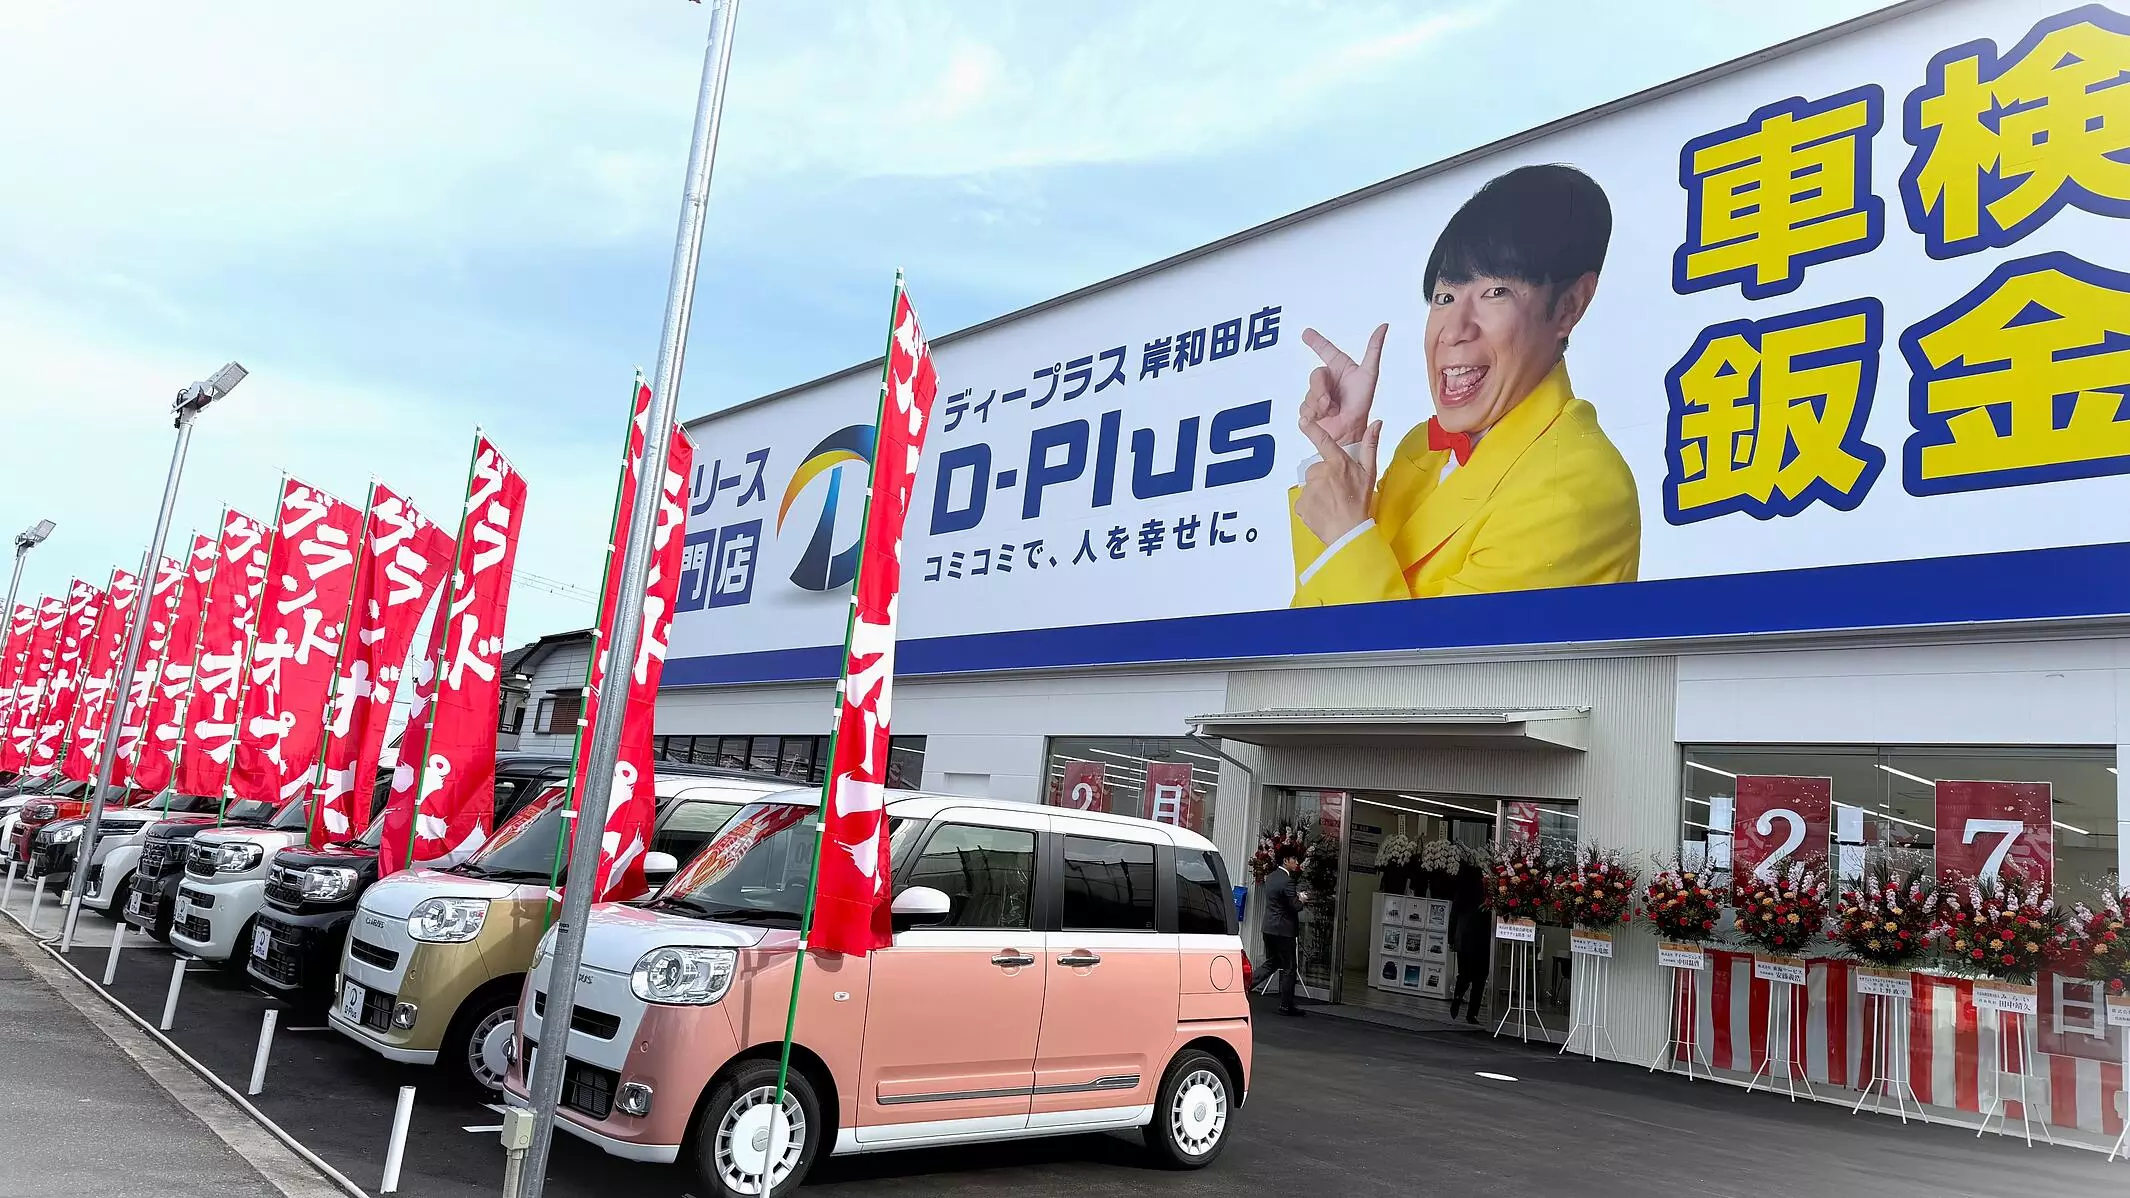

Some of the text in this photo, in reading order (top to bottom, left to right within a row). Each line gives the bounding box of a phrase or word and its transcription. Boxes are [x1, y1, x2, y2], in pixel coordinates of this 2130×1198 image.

[1673, 4, 2130, 300] 車検
[943, 304, 1283, 434] ディープラス 岸和田店
[1664, 251, 2130, 525] 鈑金
[687, 446, 772, 517] リース
[929, 398, 1276, 537] D-Plus
[923, 509, 1260, 583] コミコミで、人を幸せに。
[1753, 808, 2024, 888] 2 7
[2052, 972, 2106, 1040] 日
